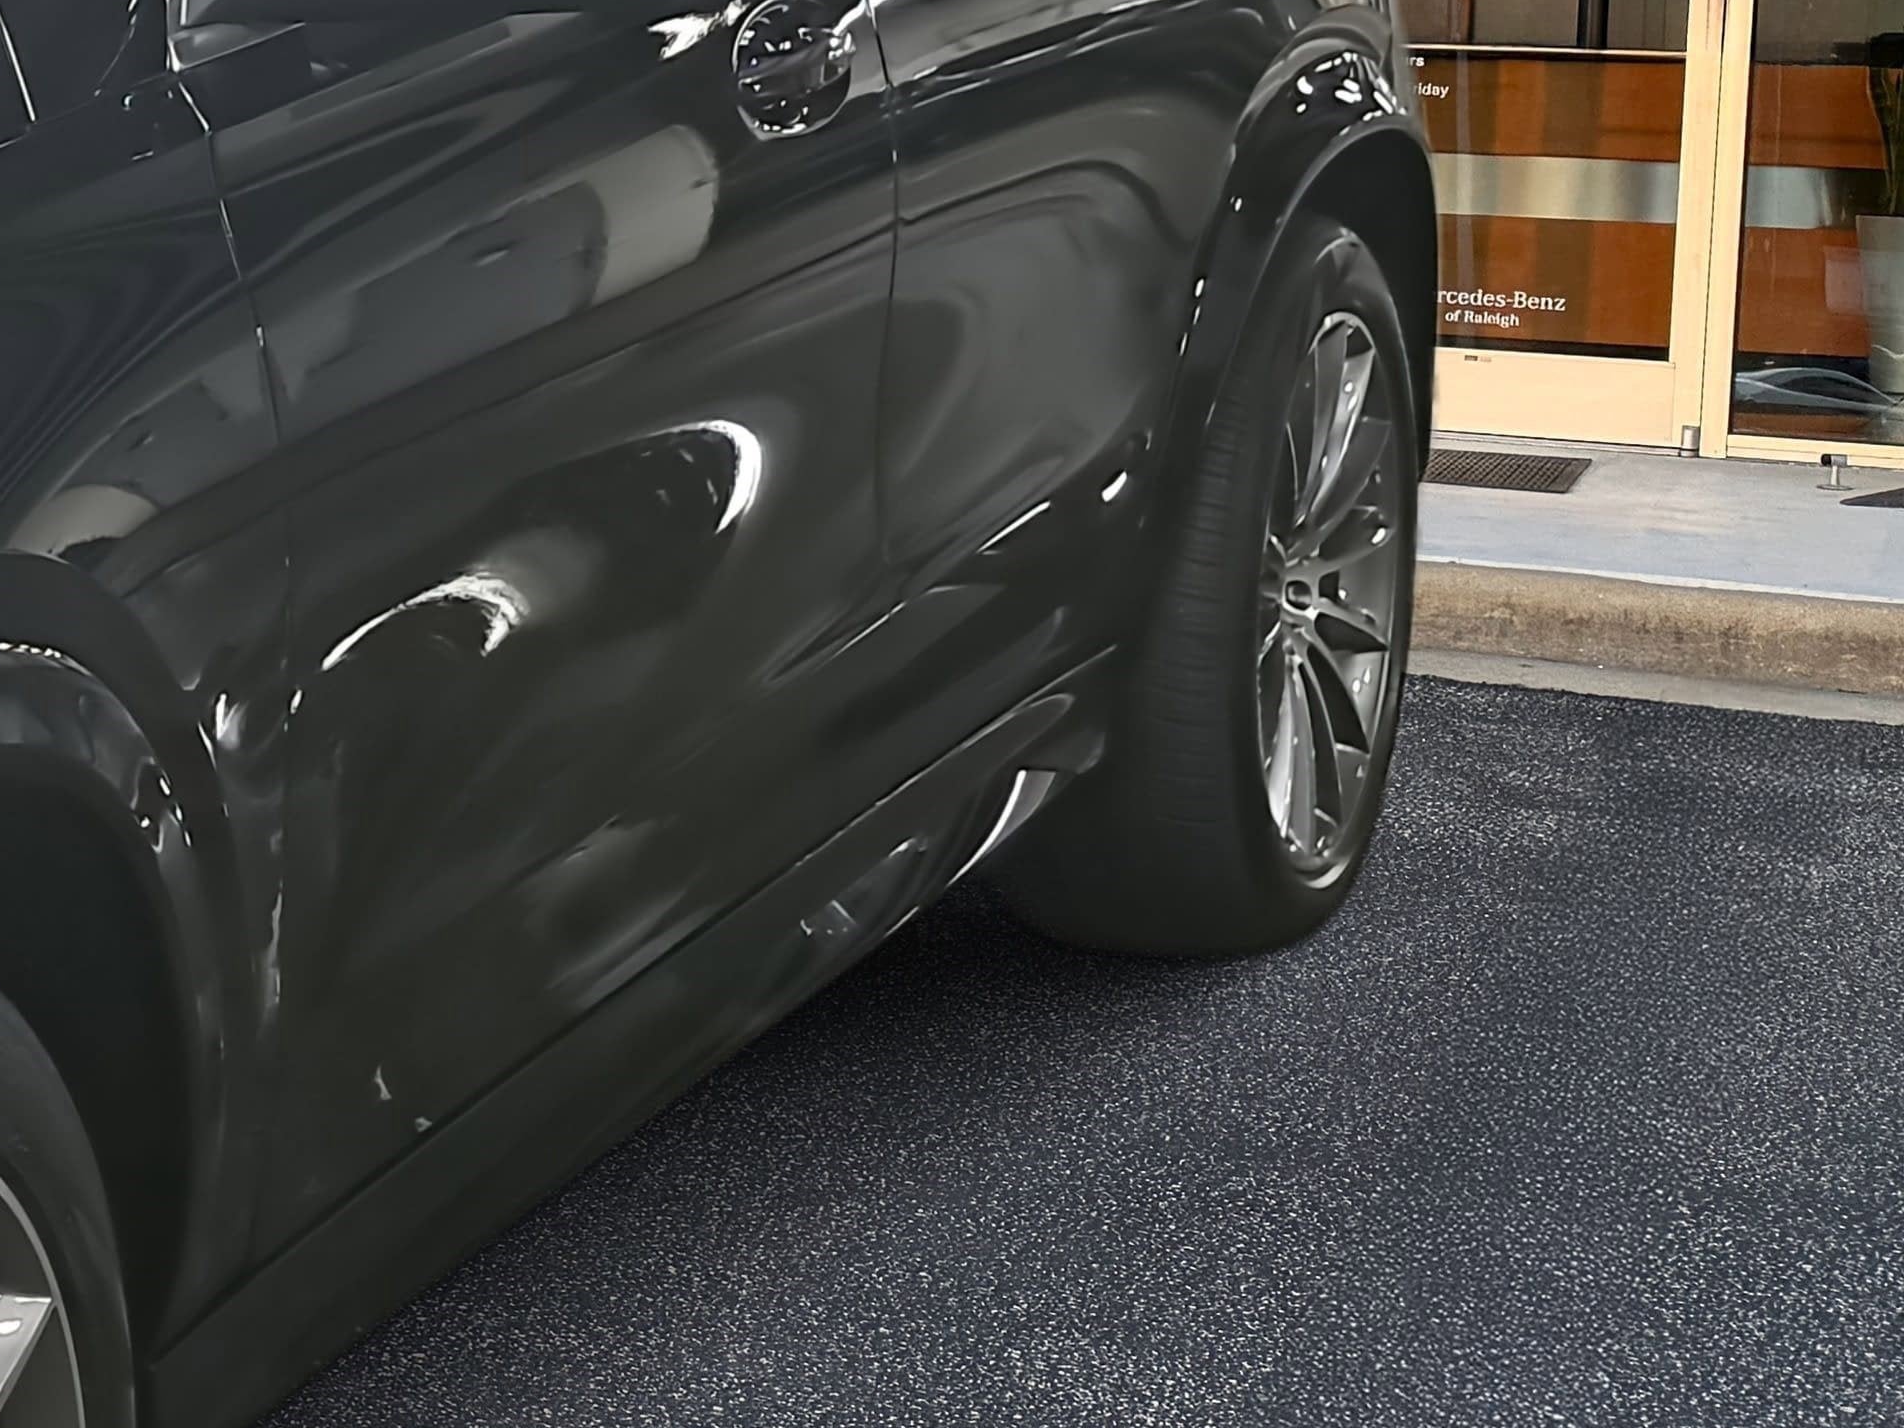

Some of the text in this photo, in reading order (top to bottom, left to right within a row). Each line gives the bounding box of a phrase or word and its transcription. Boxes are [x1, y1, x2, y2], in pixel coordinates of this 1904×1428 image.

[1437, 288, 1565, 311] rcedes-Benz
[1444, 309, 1520, 328] of Raleigh
